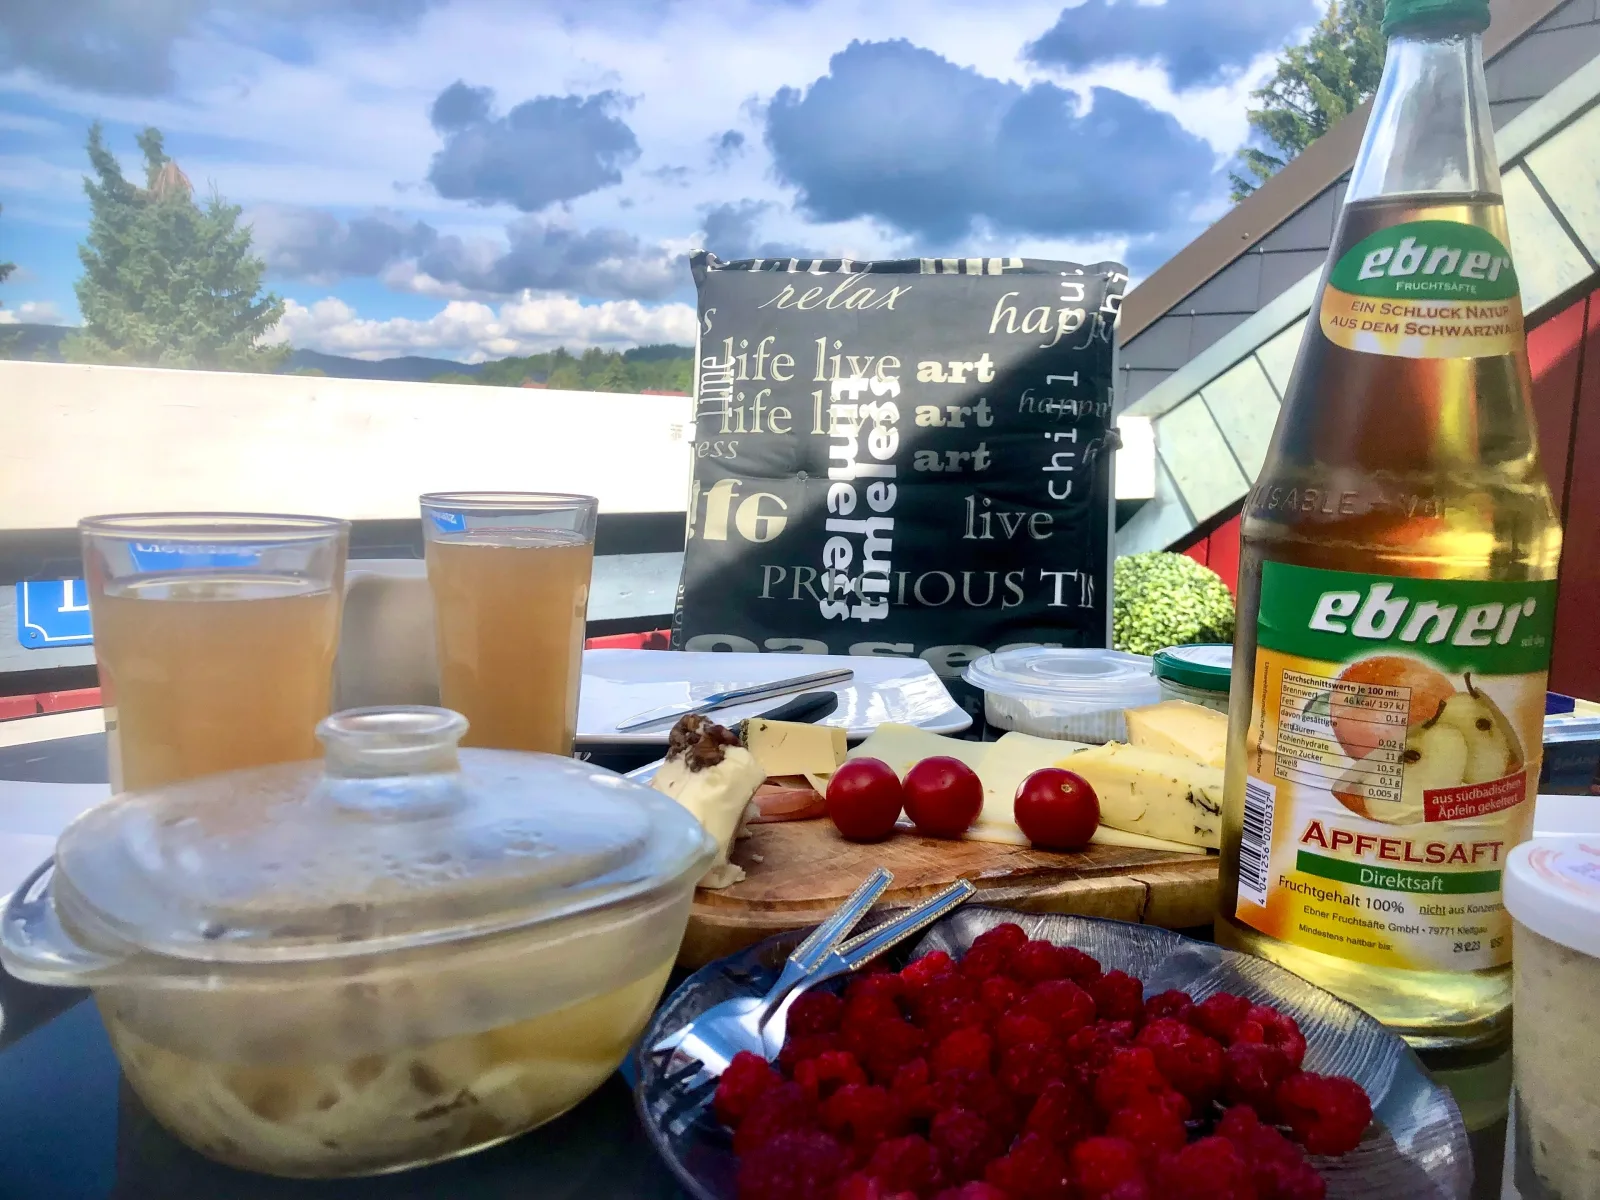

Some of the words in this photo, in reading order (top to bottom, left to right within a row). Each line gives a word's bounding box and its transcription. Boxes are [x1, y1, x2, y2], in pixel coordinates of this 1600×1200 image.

[1357, 236, 1510, 281] ebner
[757, 265, 912, 310] relax
[1351, 301, 1376, 313] EIN
[1379, 303, 1462, 319] SCHLUCK
[1330, 316, 1358, 329] AUS
[1361, 321, 1398, 334] DEM
[721, 336, 795, 382] life
[813, 336, 900, 382] live
[916, 352, 996, 384] art
[718, 388, 792, 434] life
[914, 397, 994, 428] art
[1042, 371, 1078, 500] chill
[913, 442, 992, 472] art
[962, 494, 1054, 540] live
[757, 564, 1025, 610] PRECIOUS
[1308, 581, 1536, 646] ebner
[1282, 684, 1318, 699] Brennwert
[1379, 700, 1394, 709] 197
[1283, 672, 1356, 693] Durchschnittswerte
[1357, 685, 1366, 694] je
[1367, 687, 1384, 696] 100
[1280, 708, 1300, 720] davon
[1281, 696, 1295, 706] Fett
[1386, 714, 1399, 723] 0,1
[1278, 743, 1297, 755] davon
[1298, 750, 1323, 761] Zucker
[1279, 732, 1329, 751] Kohlenhydrate
[1385, 752, 1395, 761] 11
[1378, 739, 1397, 749] 0,02
[1368, 788, 1392, 798] 0,005
[1379, 777, 1392, 786] 0,1
[1432, 794, 1453, 805] aus
[1456, 779, 1521, 803] südbadischen
[1301, 820, 1504, 864] APFELSAFT
[1278, 875, 1360, 908] Fruchtgehalt
[1366, 897, 1405, 913] 100%
[1360, 868, 1444, 891] Direktsaft
[1303, 905, 1329, 919] Ebner
[1332, 912, 1385, 930] Fruchtsäfte
[1388, 922, 1419, 934] GmbH
[1428, 926, 1455, 935] 79771
[1419, 904, 1446, 915] nicht
[1448, 906, 1465, 915] aus
[1299, 923, 1344, 943] Mindestens
[1346, 936, 1376, 949] haltbar
